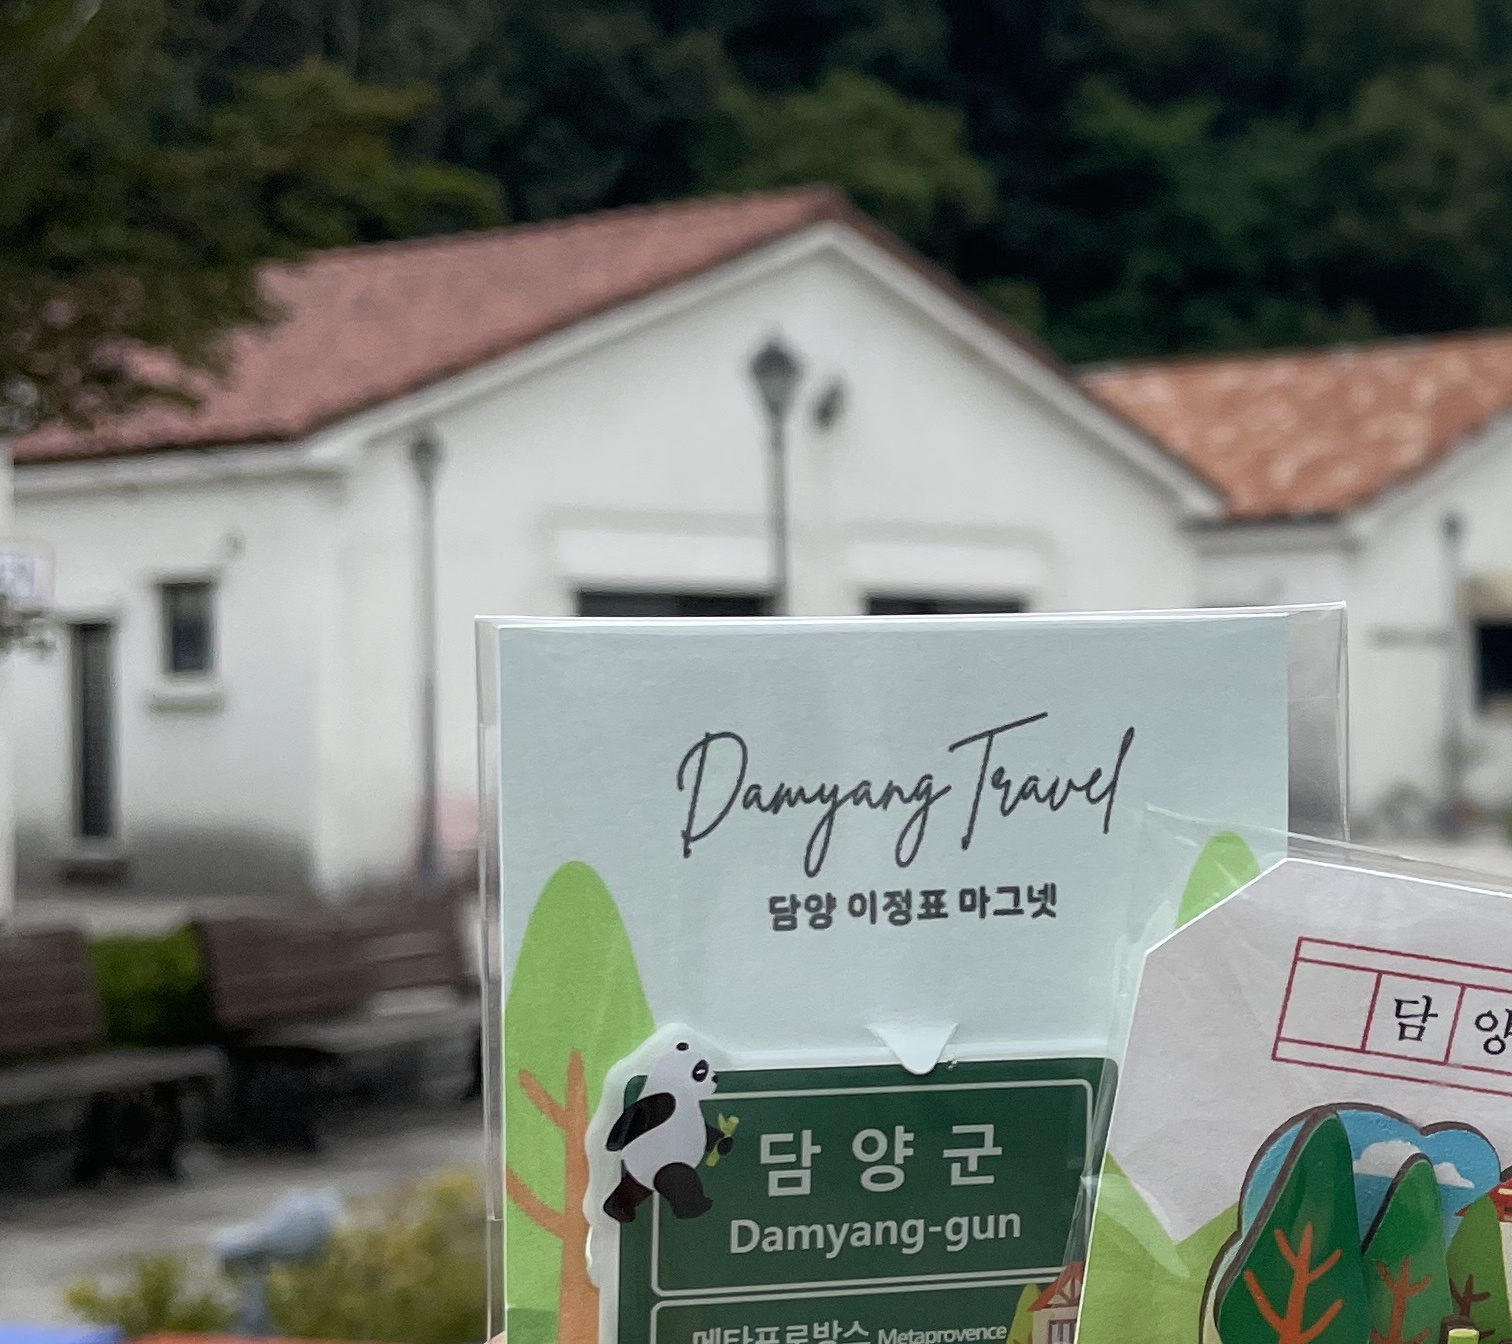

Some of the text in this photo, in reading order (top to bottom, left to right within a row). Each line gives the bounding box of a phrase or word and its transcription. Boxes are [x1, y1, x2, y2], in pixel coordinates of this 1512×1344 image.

[676, 712, 1136, 877] Damyang Travel
[768, 882, 1058, 932] 담양 이정표 마그넷
[729, 1212, 1022, 1260] Damyang-gun
